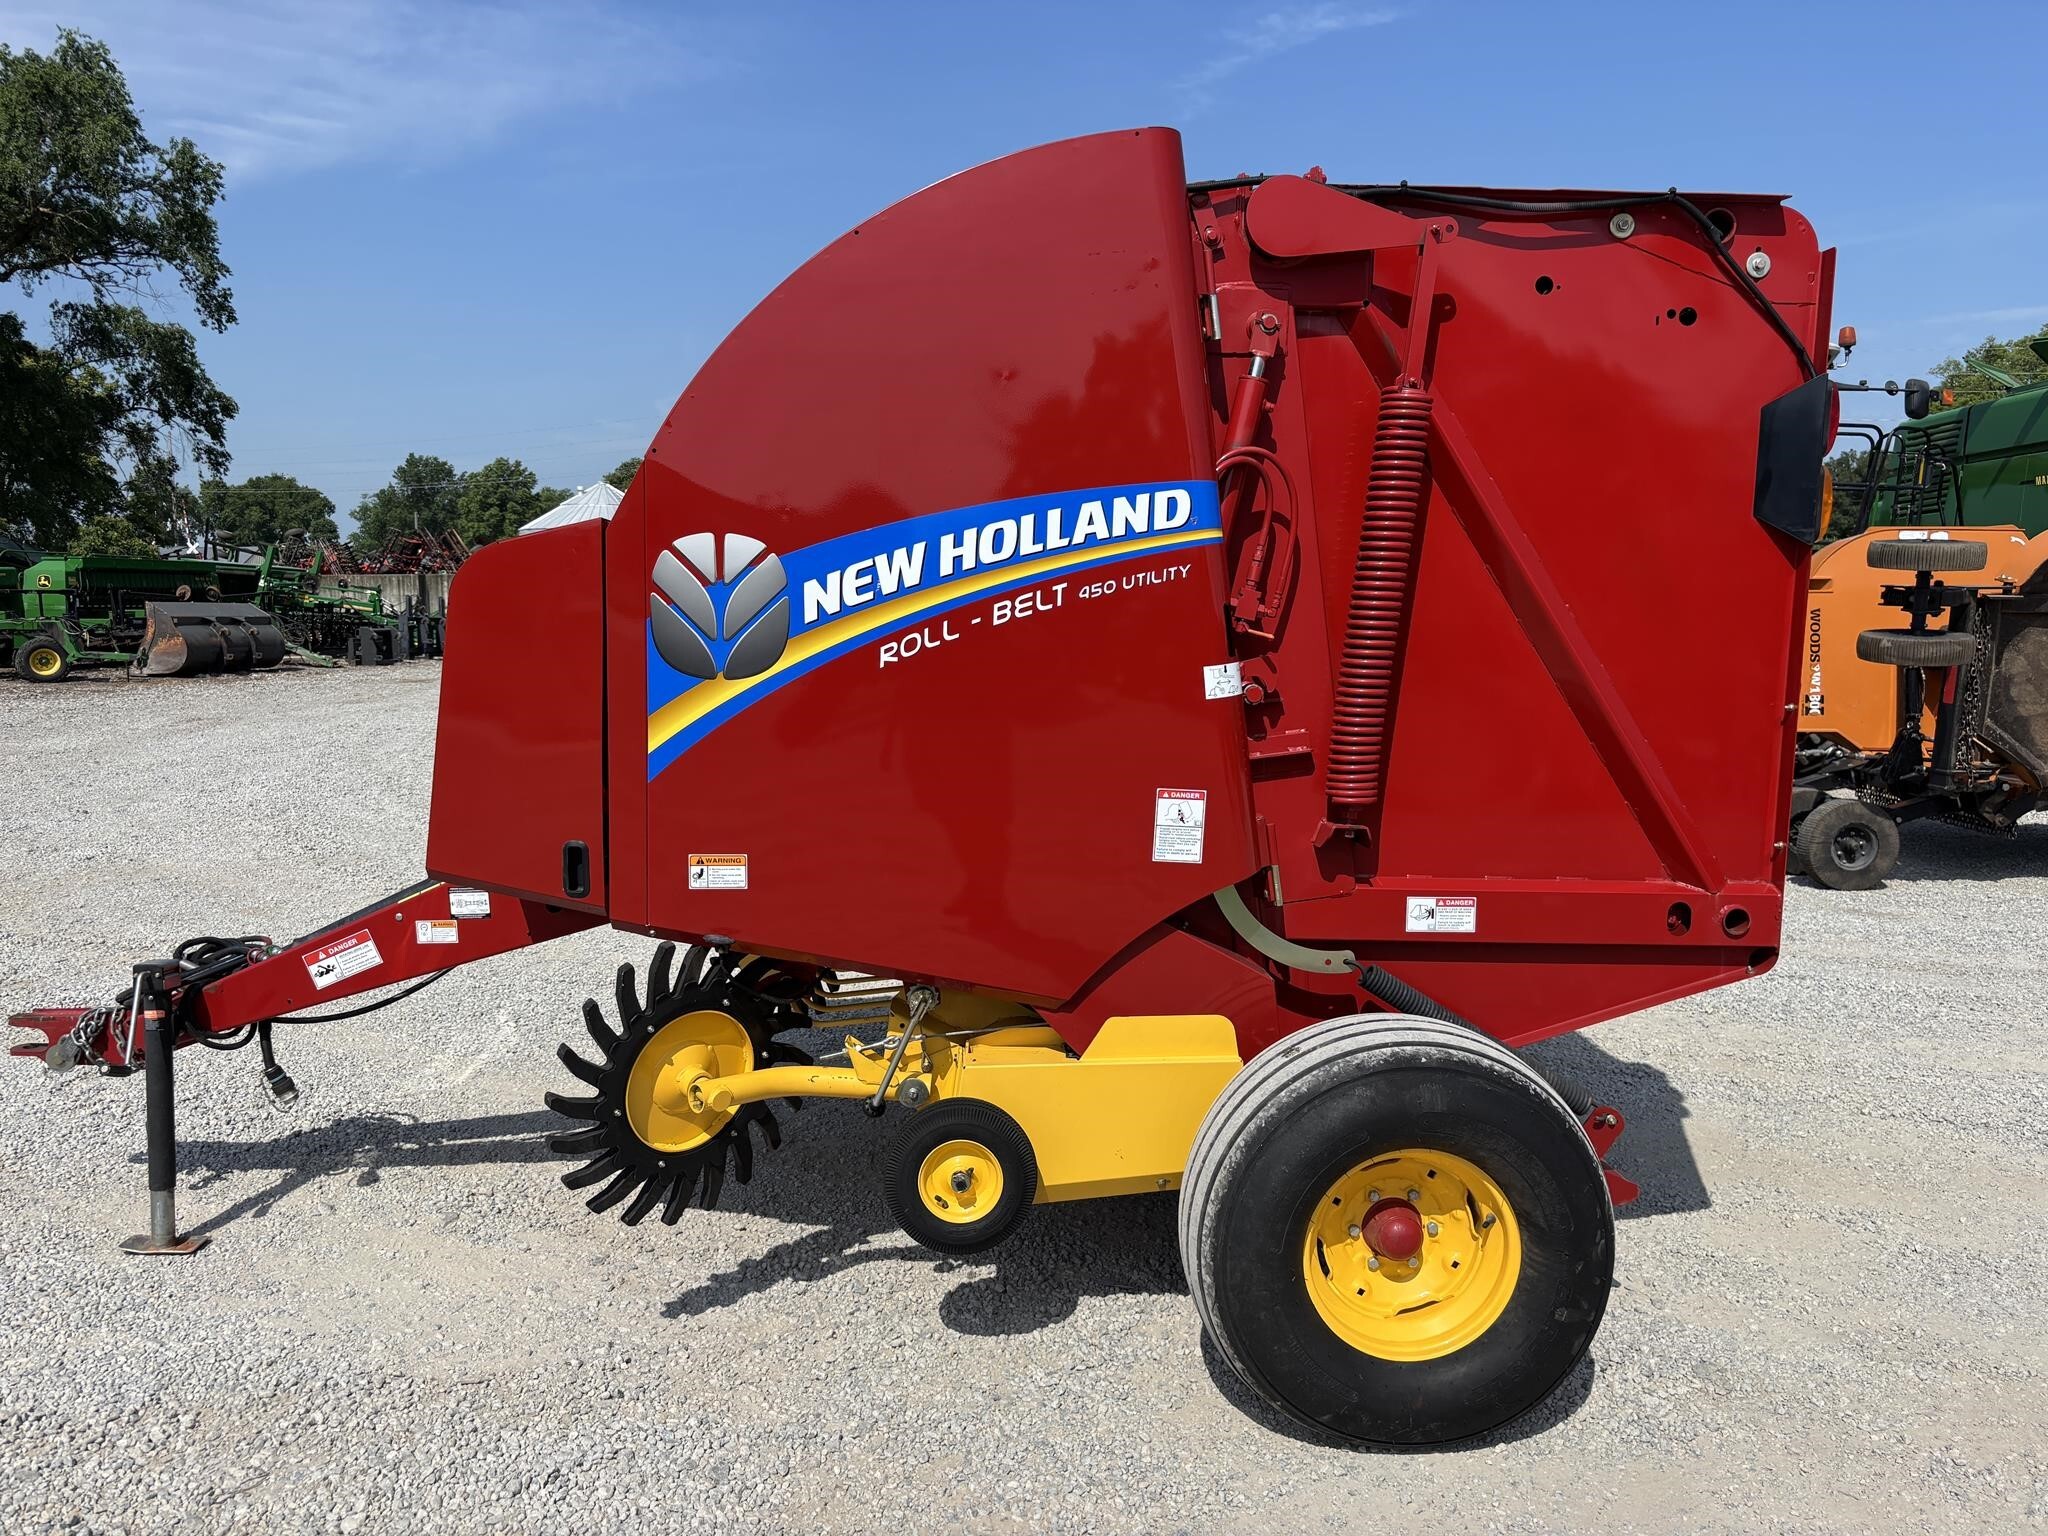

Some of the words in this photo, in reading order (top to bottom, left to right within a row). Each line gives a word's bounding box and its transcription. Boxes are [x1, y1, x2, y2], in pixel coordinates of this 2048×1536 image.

[803, 541, 926, 625] NEW
[939, 488, 1192, 577] HOLLAND
[879, 620, 960, 668] ROLL
[992, 582, 1068, 626] BELT
[1078, 579, 1117, 599] 450
[1122, 563, 1192, 590] UTILITY
[1809, 608, 1821, 663] WOODS
[328, 938, 358, 955] DANGER
